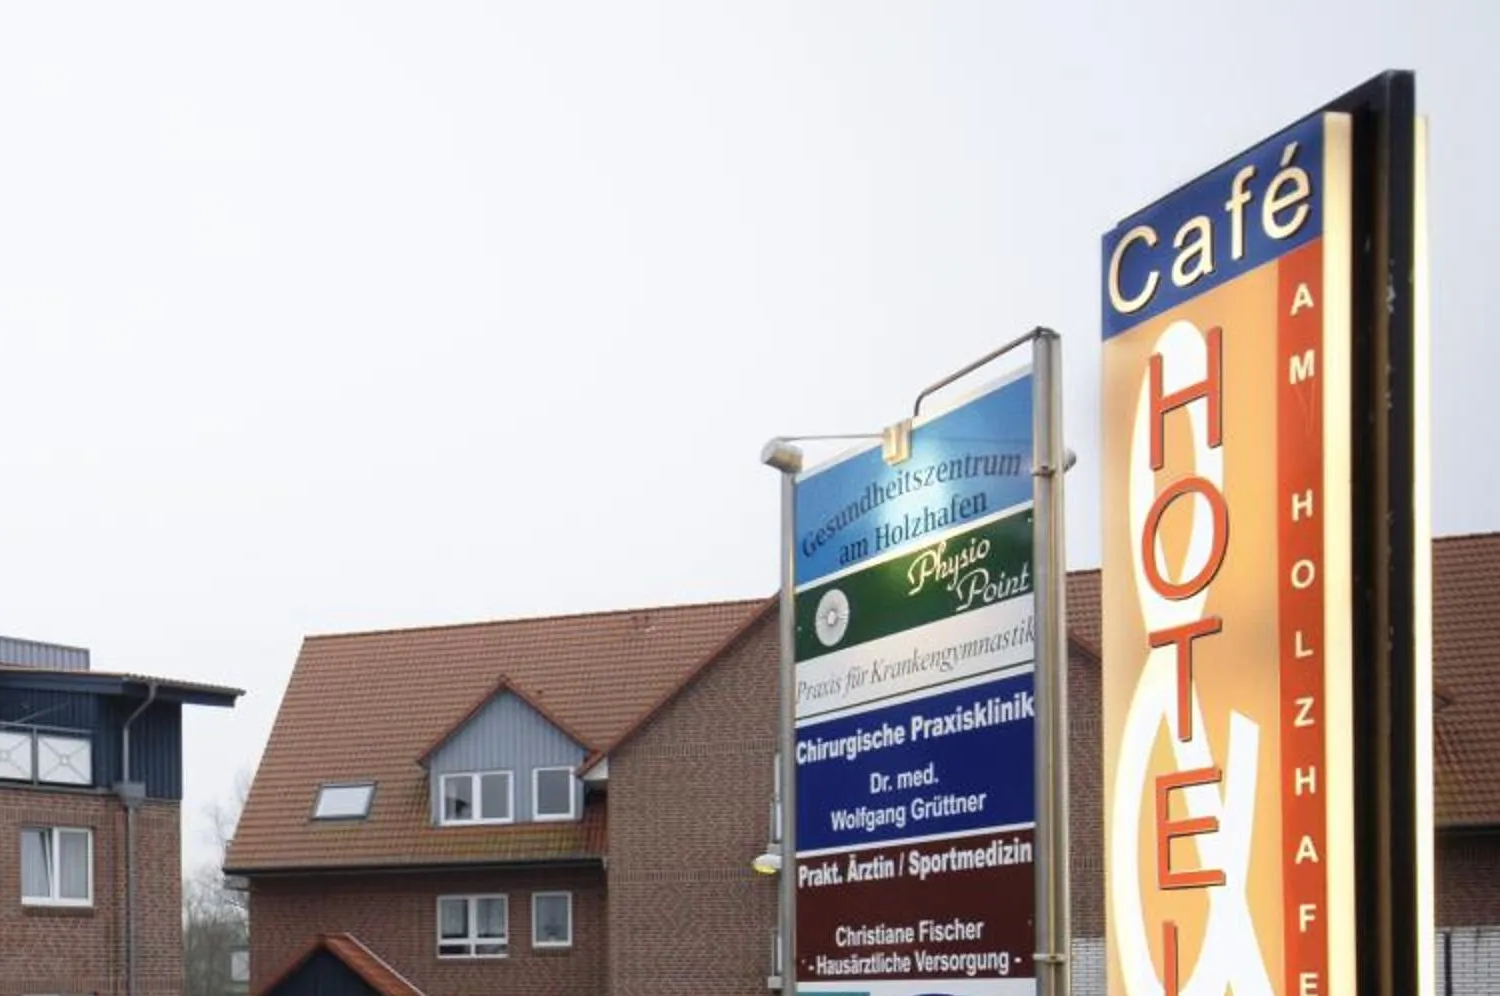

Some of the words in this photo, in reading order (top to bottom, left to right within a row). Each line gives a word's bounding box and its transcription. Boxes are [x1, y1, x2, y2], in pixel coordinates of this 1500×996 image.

[1107, 142, 1313, 315] Café
[1289, 282, 1316, 385] AM
[802, 449, 1022, 560] Gesundheitszentrum
[839, 537, 869, 565] am
[875, 491, 988, 554] Holzhafen
[907, 536, 991, 596] Physio
[955, 562, 1030, 612] Point
[797, 678, 842, 702] Praxis
[843, 662, 869, 699] für
[870, 615, 1035, 684] Krankengymnastik
[795, 723, 905, 765] Chirurgische
[910, 690, 1035, 742] Praxisklinik
[869, 771, 893, 794] Dr.
[896, 761, 939, 790] med.
[830, 804, 906, 832] Wolfgang
[910, 790, 988, 821] Grüttner
[798, 863, 843, 888] Prakt.
[846, 849, 895, 884] Ärztin
[908, 837, 1033, 880] Sportmedizin
[835, 924, 914, 949] Christiane
[918, 918, 985, 943] Fischer
[915, 950, 1009, 977] Versorgung
